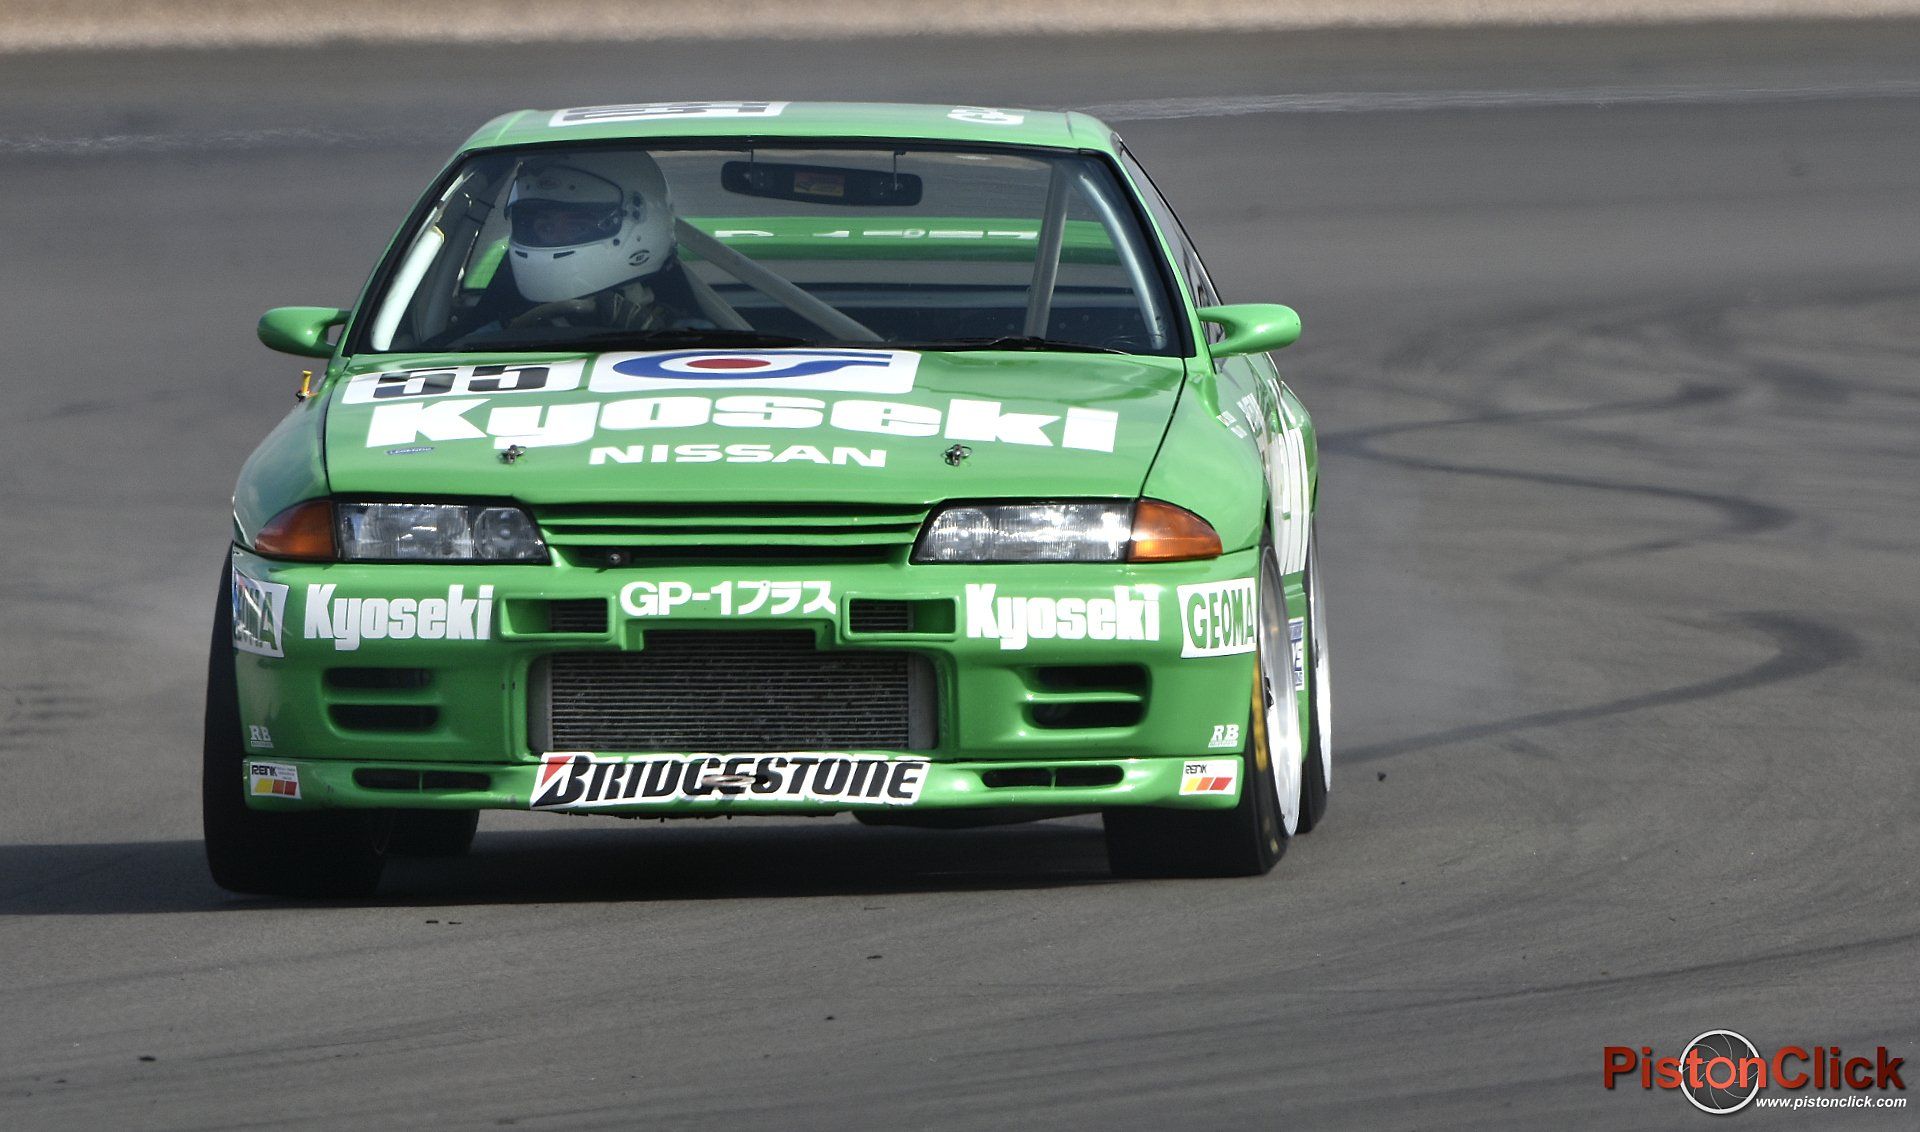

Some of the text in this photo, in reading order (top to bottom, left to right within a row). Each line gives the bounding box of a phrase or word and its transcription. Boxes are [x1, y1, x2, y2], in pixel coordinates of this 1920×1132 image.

[373, 365, 551, 399] 55
[366, 395, 1118, 453] Kyoseki
[589, 444, 887, 468] NISSAN
[303, 583, 495, 650] Kyoseki
[620, 580, 837, 617] GP-1プラス
[965, 583, 1159, 650] Kyoseki
[1187, 586, 1256, 649] GEOMA
[533, 755, 924, 805] BRIDGESTONE
